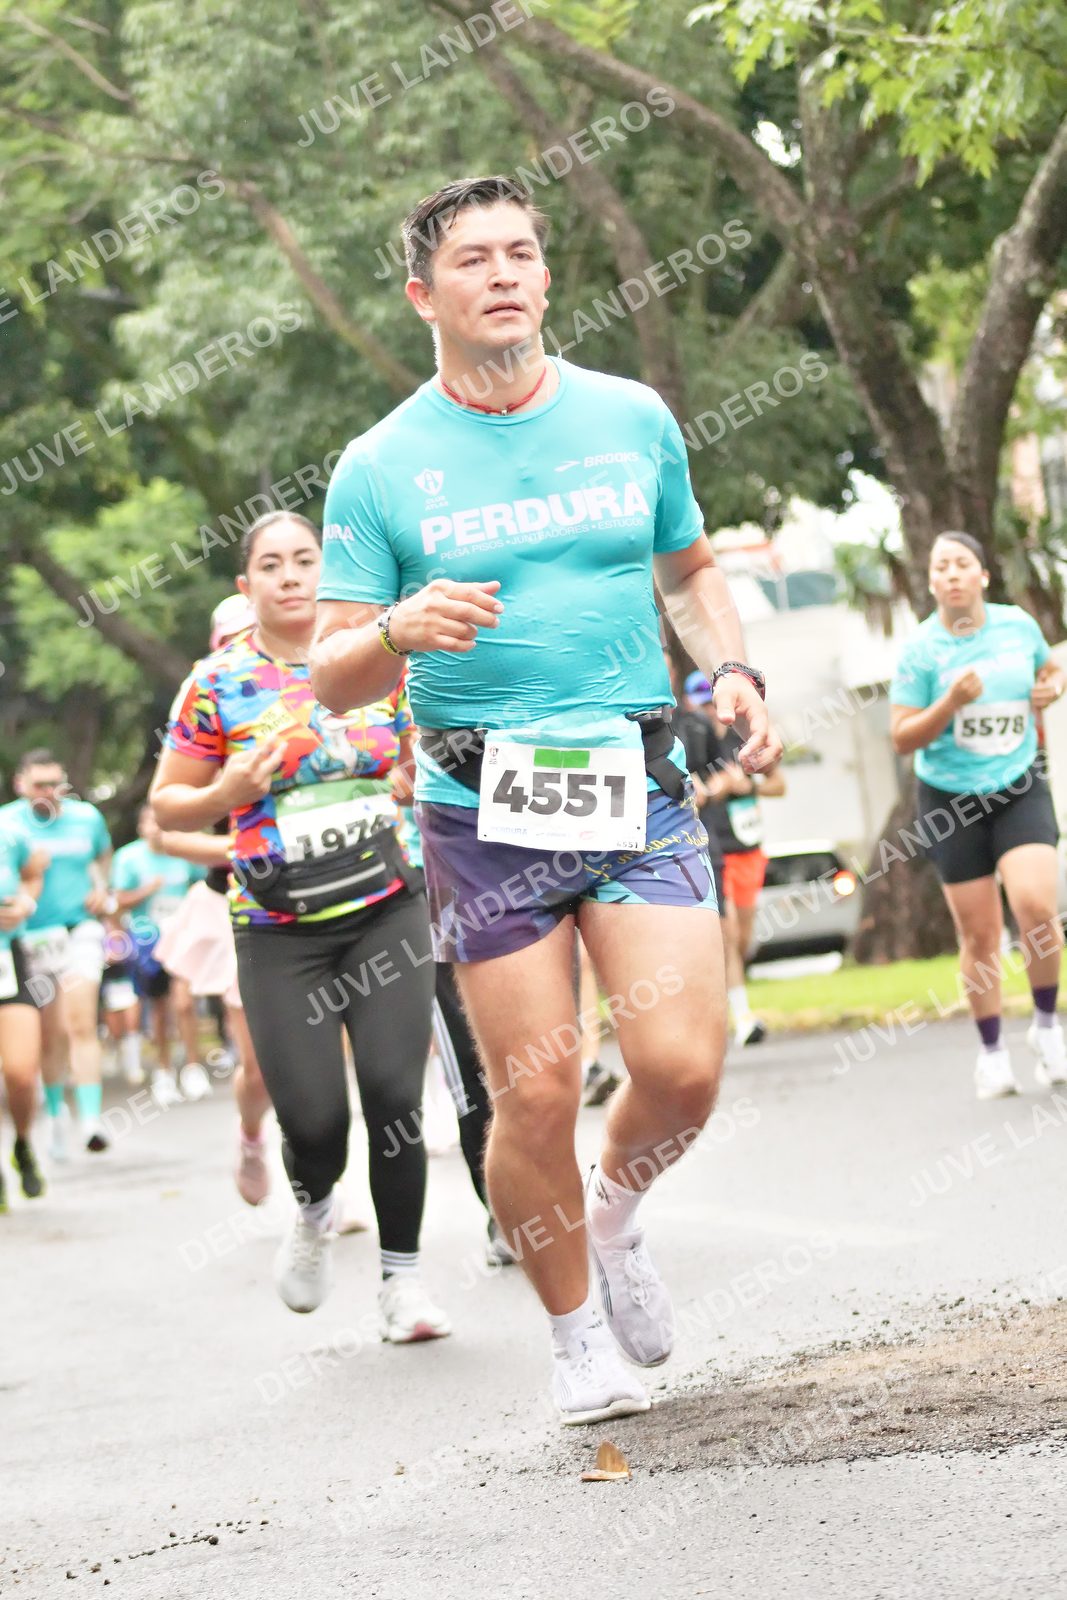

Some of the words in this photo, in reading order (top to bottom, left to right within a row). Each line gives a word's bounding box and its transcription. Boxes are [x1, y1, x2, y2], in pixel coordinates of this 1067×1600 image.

[584, 452, 639, 469] BROOKS
[420, 481, 650, 556] PERDURA
[440, 548, 470, 562] PEGA
[471, 540, 504, 554] PISOS
[511, 523, 590, 545] JUNTEADORES
[962, 715, 1025, 738] 5578
[493, 769, 626, 818] 4551
[616, 842, 639, 850] 4551
